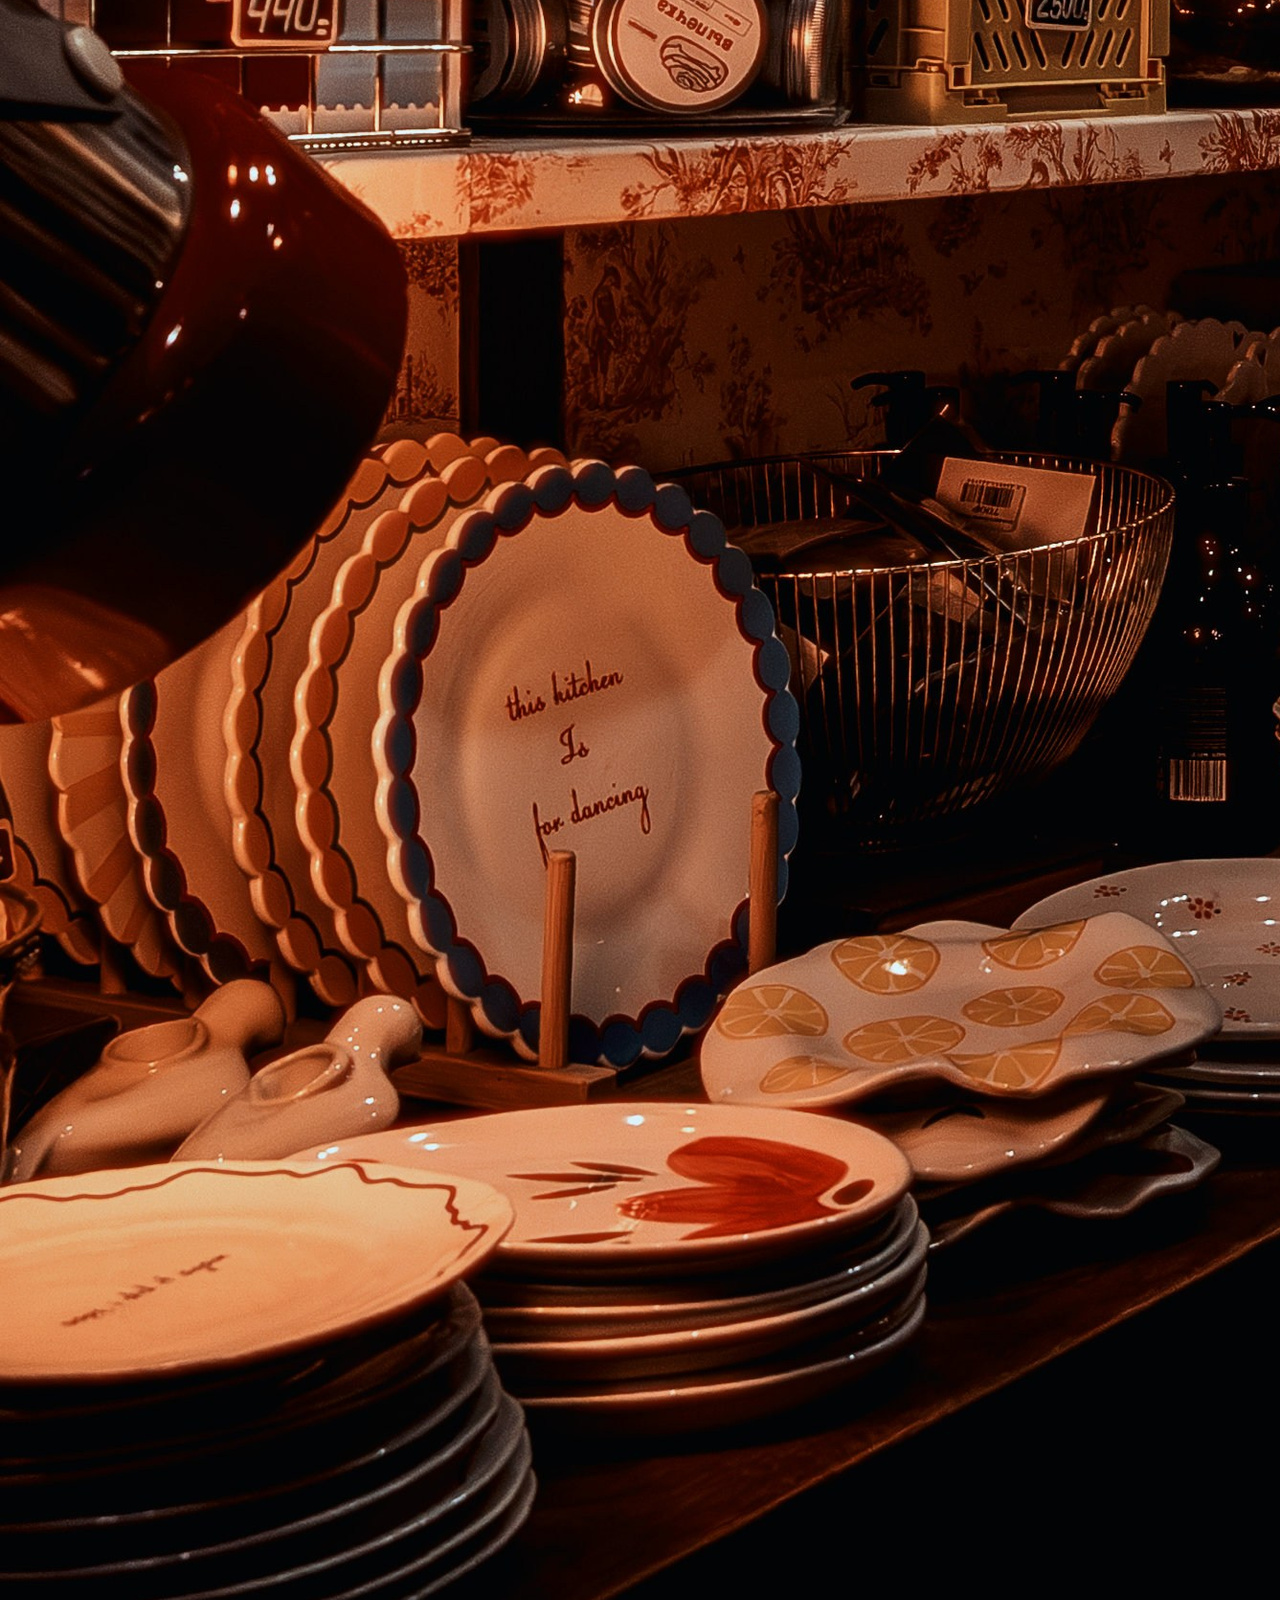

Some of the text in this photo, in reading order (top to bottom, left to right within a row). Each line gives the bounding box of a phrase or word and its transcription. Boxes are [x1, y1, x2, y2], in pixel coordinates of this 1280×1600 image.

[504, 659, 624, 722] this kitchen
[559, 723, 590, 766] Is
[532, 782, 651, 871] for dancing
